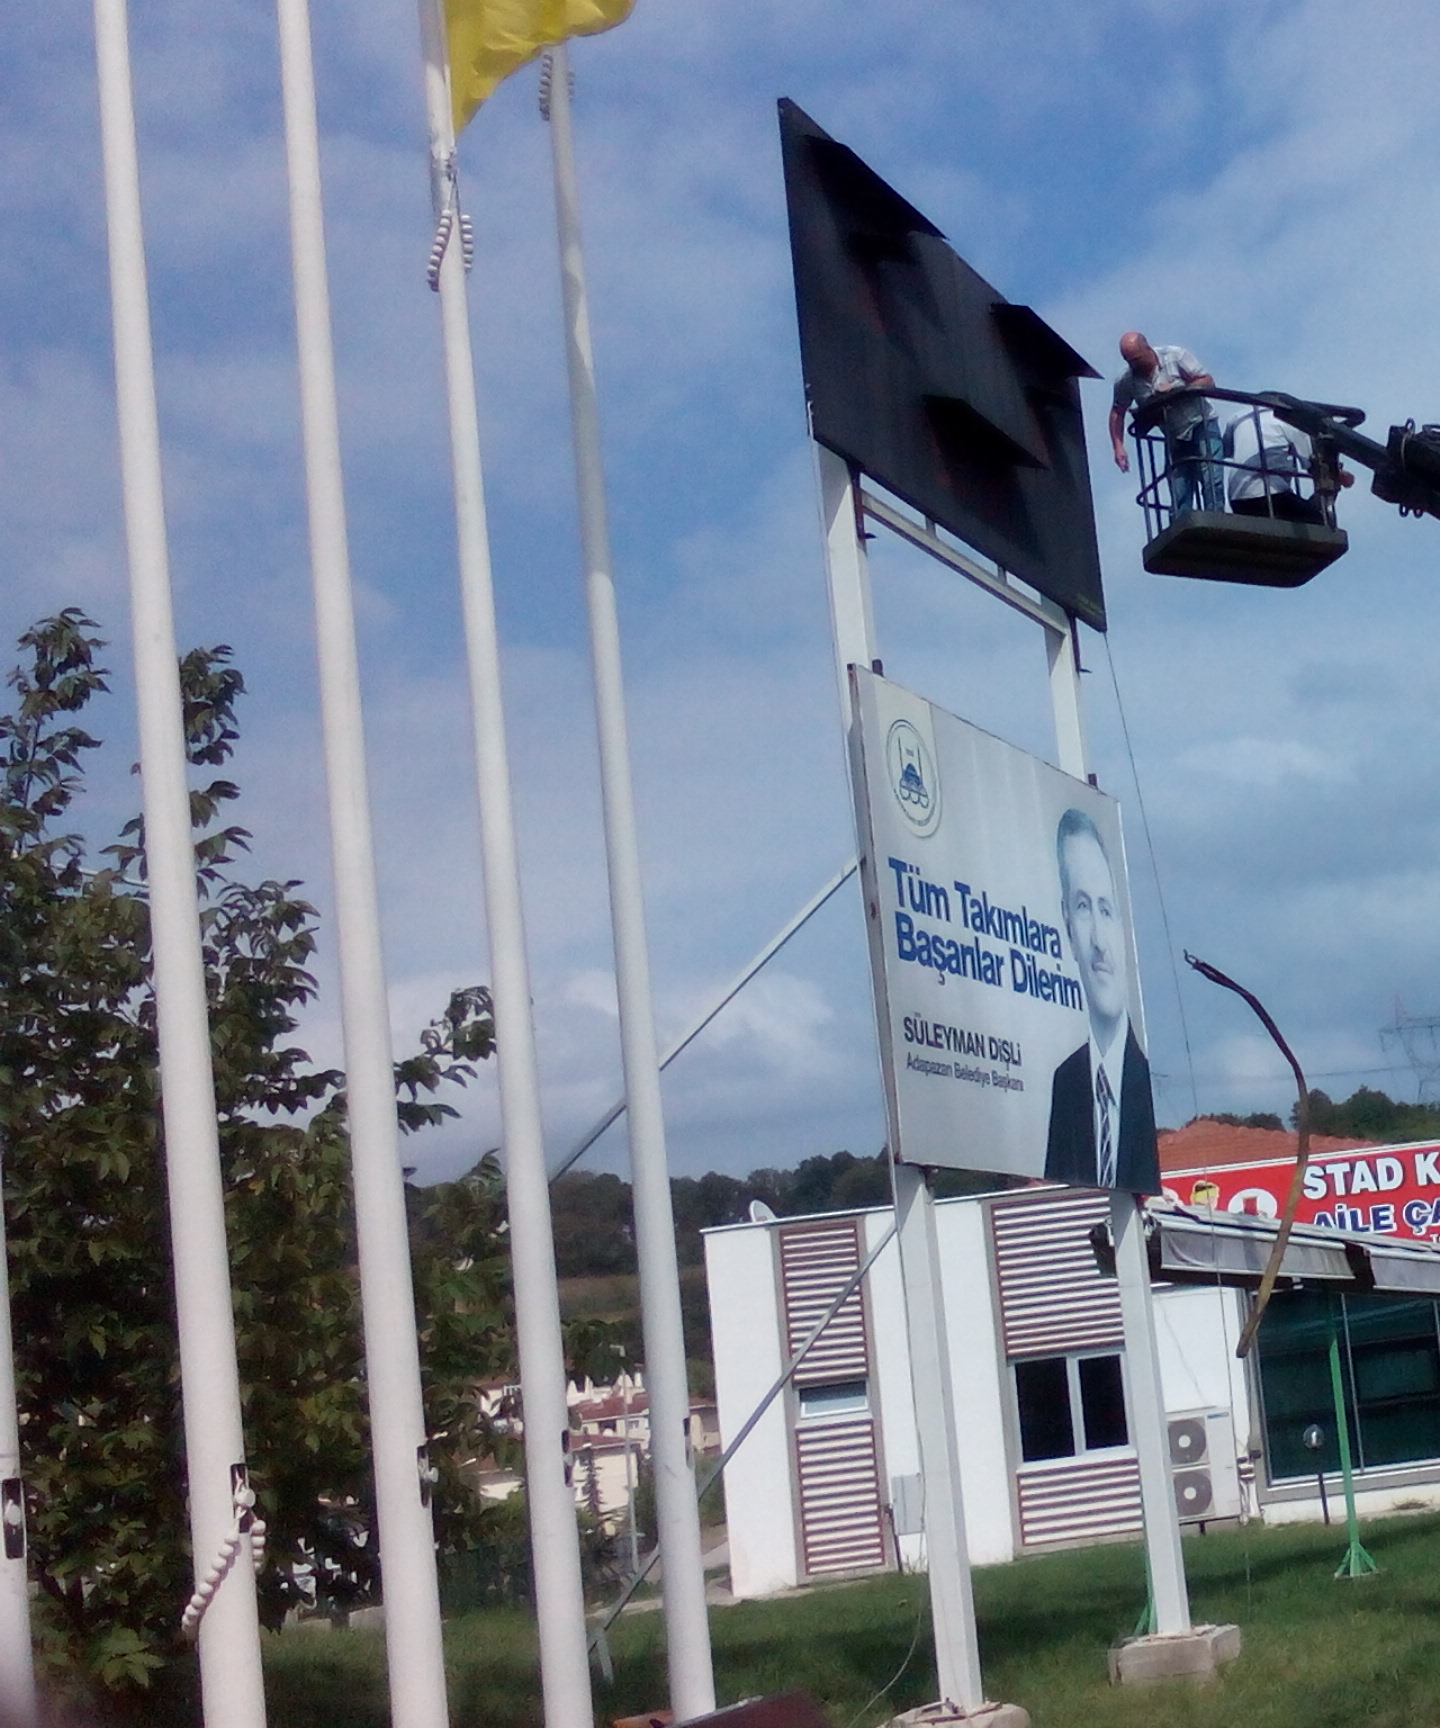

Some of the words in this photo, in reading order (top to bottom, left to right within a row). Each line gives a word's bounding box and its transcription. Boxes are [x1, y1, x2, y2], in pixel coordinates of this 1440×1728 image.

[888, 857, 951, 922] Tüm
[954, 880, 1063, 960] Takımlara
[894, 911, 1005, 987] Başarılar
[1009, 947, 1083, 1010] Dilerim
[903, 1011, 986, 1059] SÜLEYMAN
[1303, 1157, 1405, 1200] STAD
[1314, 1203, 1397, 1233] AİLE
